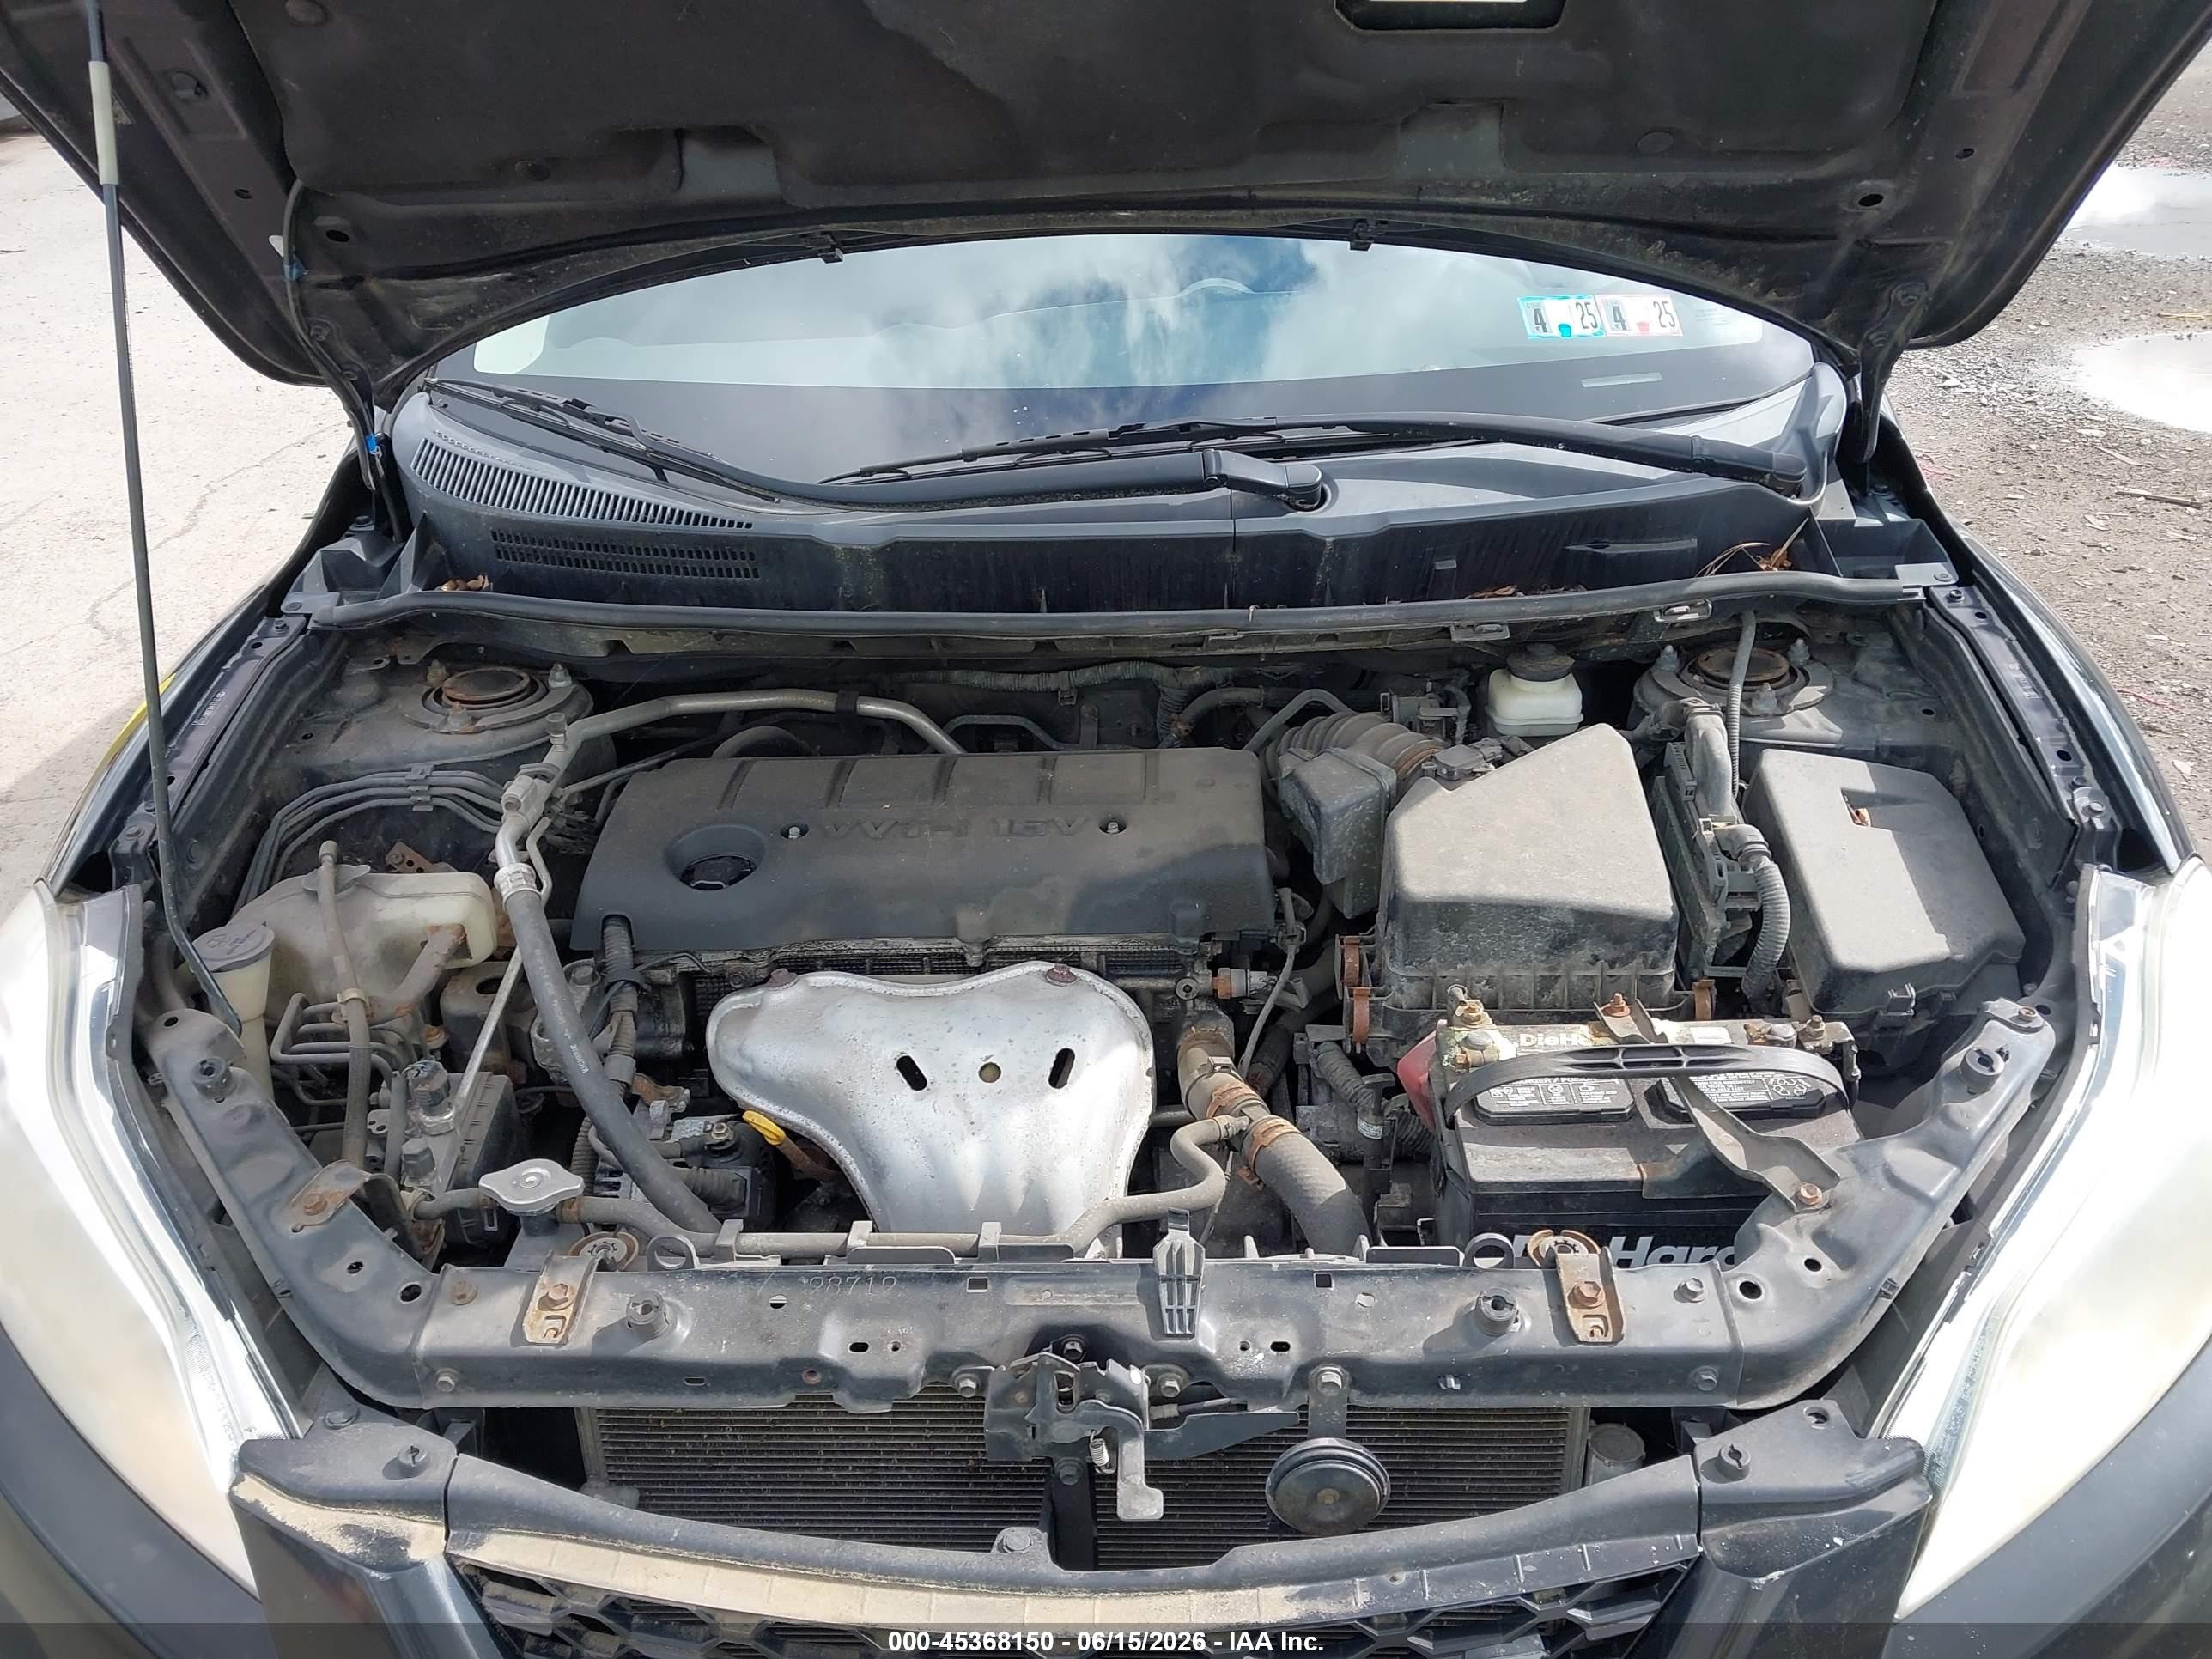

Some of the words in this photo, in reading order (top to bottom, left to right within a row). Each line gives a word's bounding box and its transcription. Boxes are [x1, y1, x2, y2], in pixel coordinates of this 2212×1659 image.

[1534, 308, 1548, 333] 4
[1576, 301, 1598, 330] 25
[1613, 306, 1627, 331] 4
[1653, 301, 1676, 328] 25
[1519, 1033, 1594, 1047] DieH
